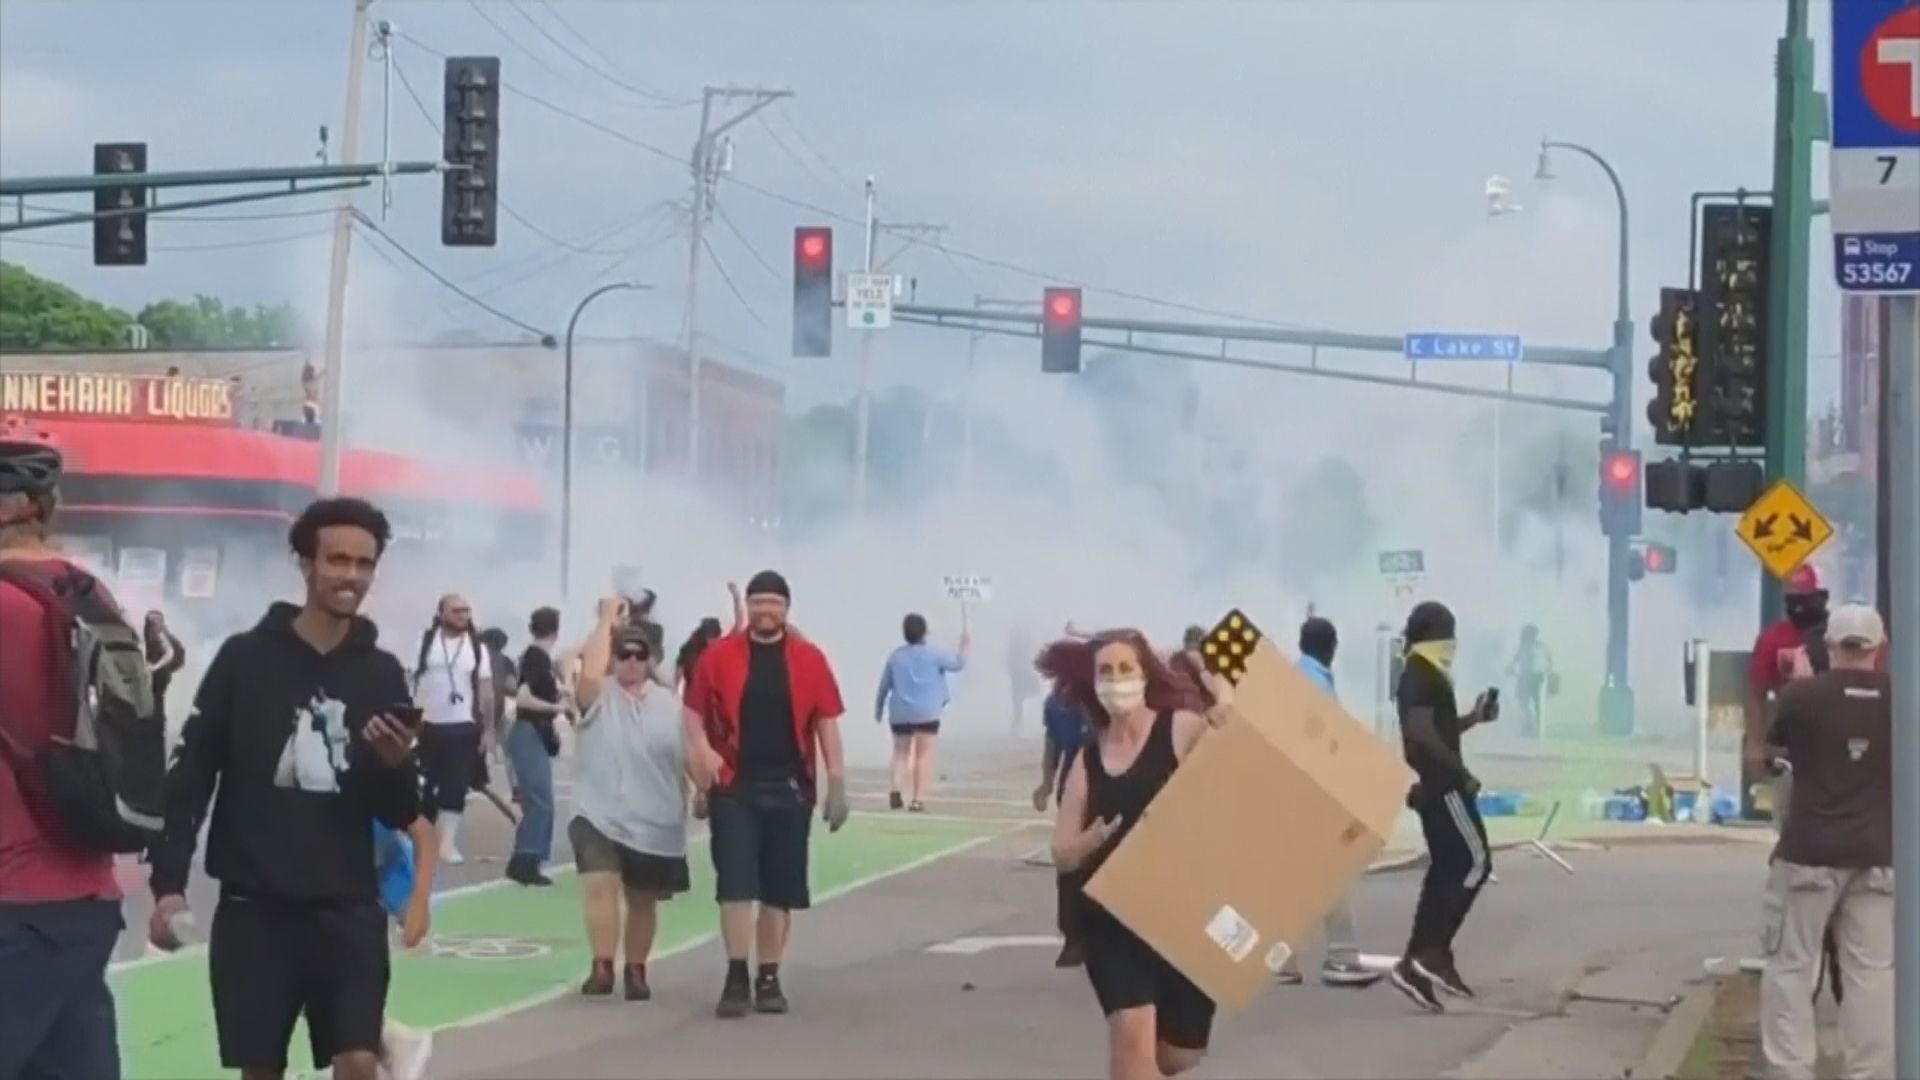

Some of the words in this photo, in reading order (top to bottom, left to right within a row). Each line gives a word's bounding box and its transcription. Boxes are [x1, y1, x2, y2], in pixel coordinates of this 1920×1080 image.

[1876, 156, 1897, 185] 7
[1864, 240, 1899, 258] Stop
[1844, 262, 1912, 283] 53567
[1410, 338, 1422, 355] E
[1433, 338, 1481, 355] Lake
[1493, 339, 1515, 356] St
[147, 377, 233, 419] LIQUORS
